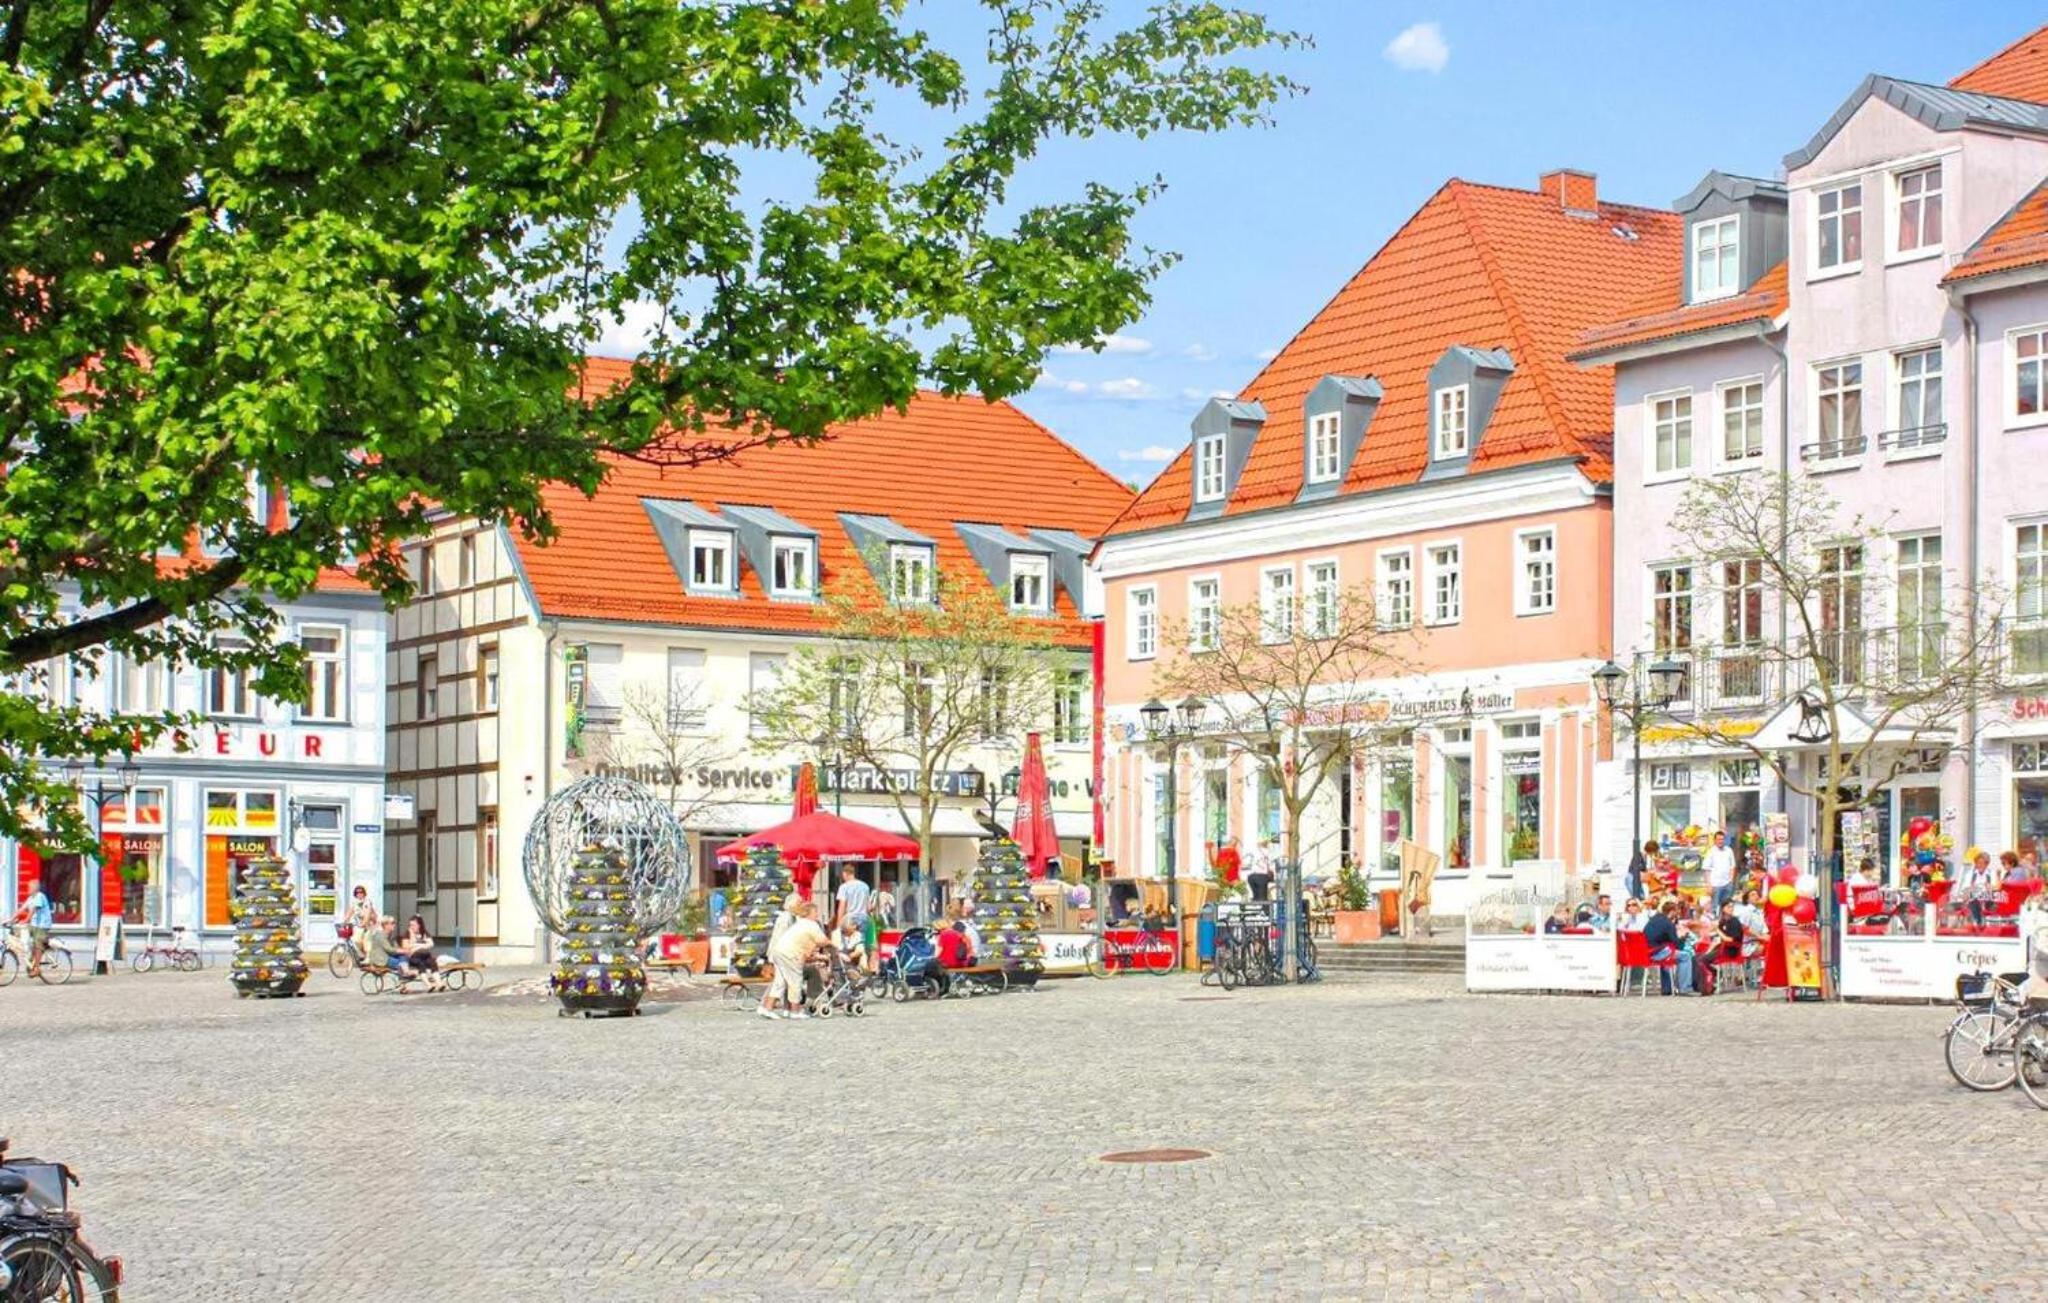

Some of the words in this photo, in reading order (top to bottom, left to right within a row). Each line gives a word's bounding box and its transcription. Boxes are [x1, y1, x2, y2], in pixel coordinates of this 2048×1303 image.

[697, 765, 774, 788] Service
[827, 769, 950, 792] Marktpltz
[124, 839, 161, 851] SALON
[229, 841, 265, 853] SALON
[1956, 950, 1999, 967] Crêpes
